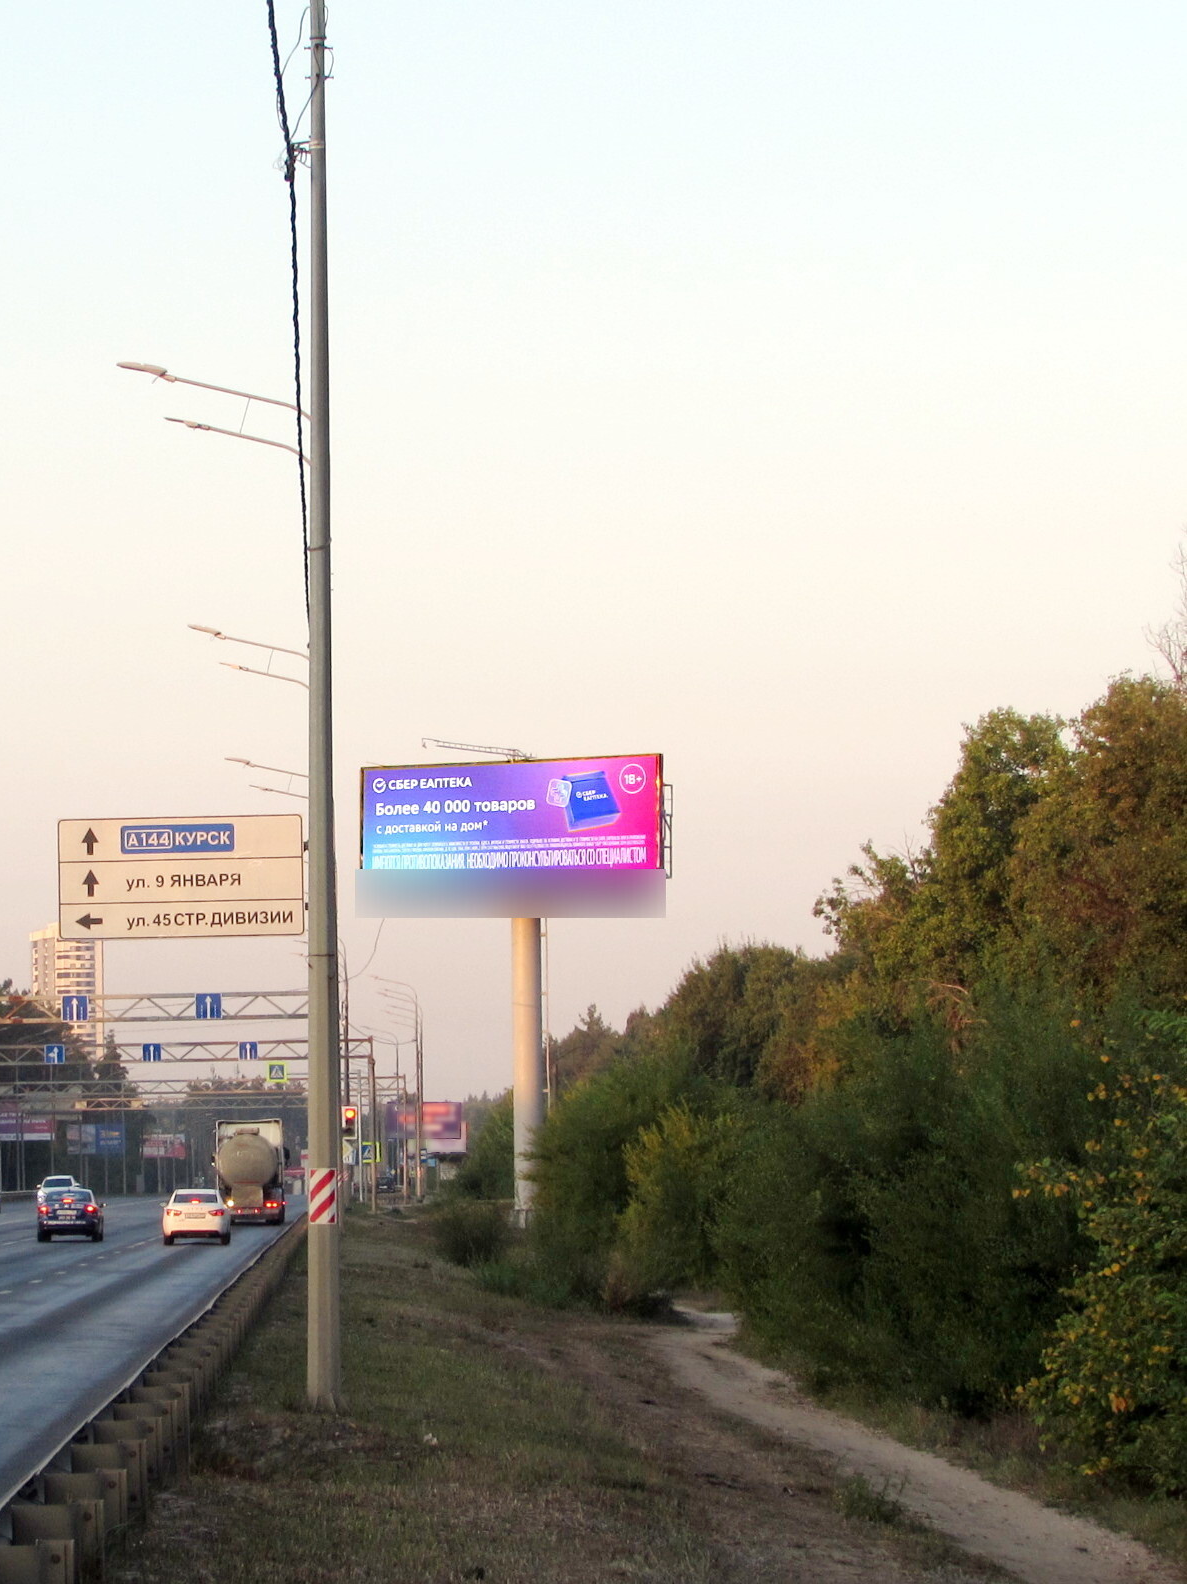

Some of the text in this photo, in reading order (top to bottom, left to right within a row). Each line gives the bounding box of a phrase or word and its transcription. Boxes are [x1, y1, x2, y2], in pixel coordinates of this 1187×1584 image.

[388, 777, 473, 790] СБЕР ЕАПТЕКА
[624, 774, 643, 785] 18+
[375, 799, 536, 816] Более 40 000 товаров
[376, 825, 382, 834] с
[384, 821, 442, 835] доставкой
[444, 822, 458, 832] на
[175, 831, 231, 846] КУРСК
[126, 873, 242, 892] ул. 9 ЯНВАРЯ
